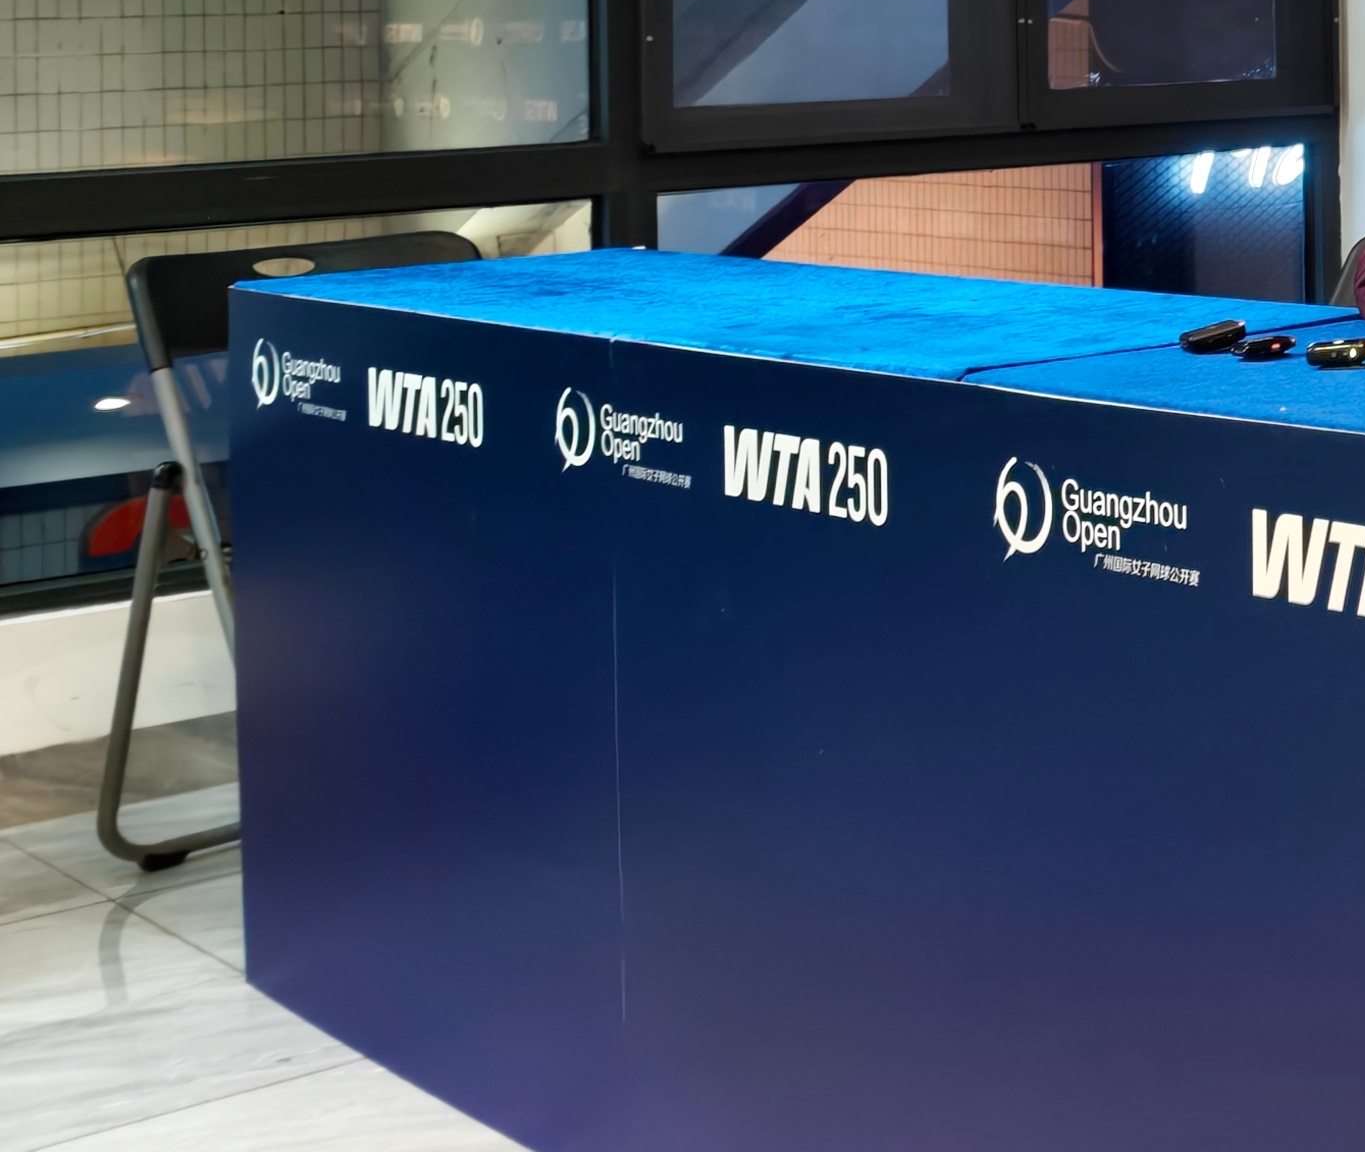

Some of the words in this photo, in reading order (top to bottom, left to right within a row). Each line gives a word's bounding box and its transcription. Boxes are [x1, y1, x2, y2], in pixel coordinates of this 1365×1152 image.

[367, 366, 437, 439] WTA
[440, 378, 484, 448] 250
[600, 404, 683, 446] Guangzhou
[601, 432, 640, 463] Open
[723, 424, 821, 514] WTA
[827, 441, 889, 527] 250
[1061, 478, 1187, 531] Guangzhou
[1063, 517, 1120, 553] Open
